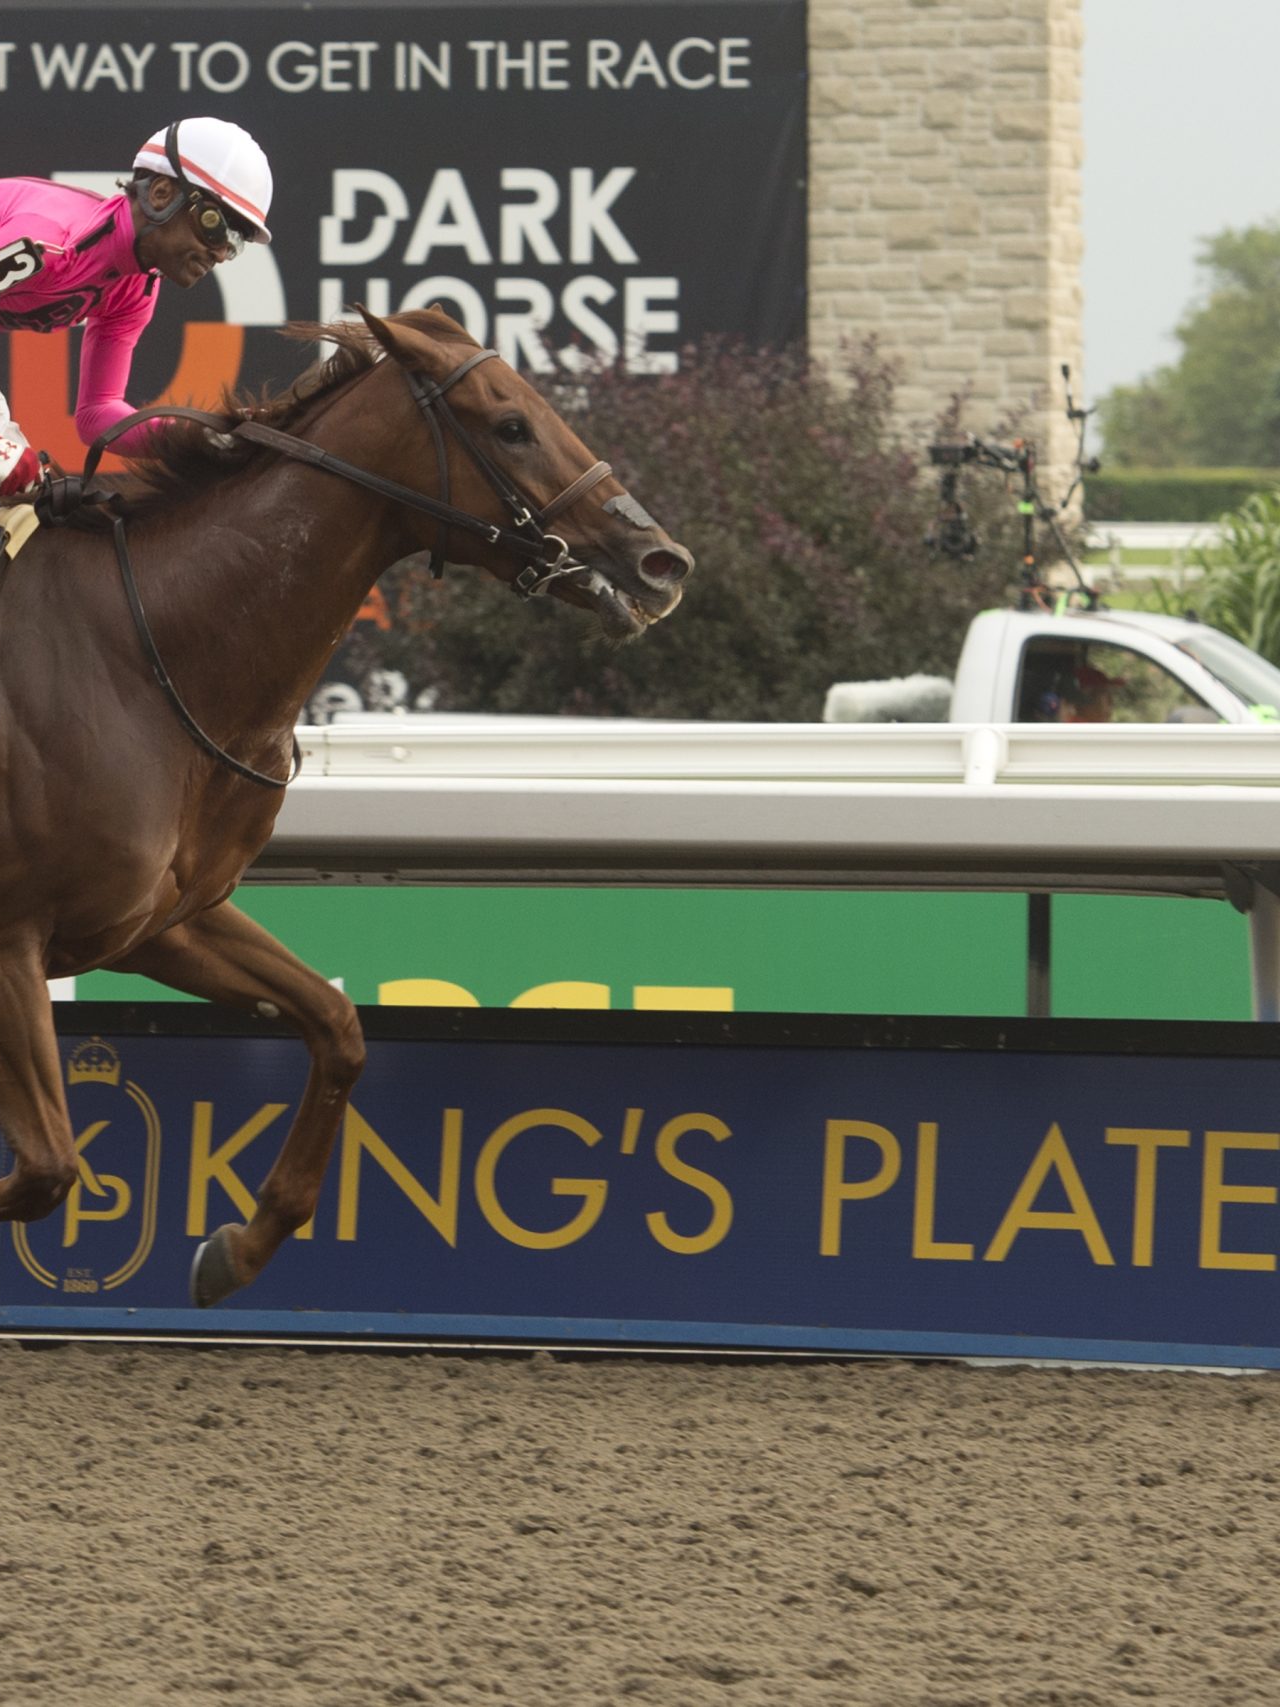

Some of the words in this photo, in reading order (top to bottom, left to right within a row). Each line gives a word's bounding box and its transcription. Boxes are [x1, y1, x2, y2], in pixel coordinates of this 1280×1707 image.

[31, 43, 155, 91] WAY
[171, 41, 250, 93] TO
[267, 41, 379, 93] GET
[395, 42, 451, 90] IN
[468, 40, 570, 90] THE
[588, 37, 751, 90] RACE
[319, 167, 639, 265] DARK
[319, 275, 679, 374] HORSE
[185, 1101, 734, 1256] KNG'S
[819, 1118, 1280, 1273] PLATE
